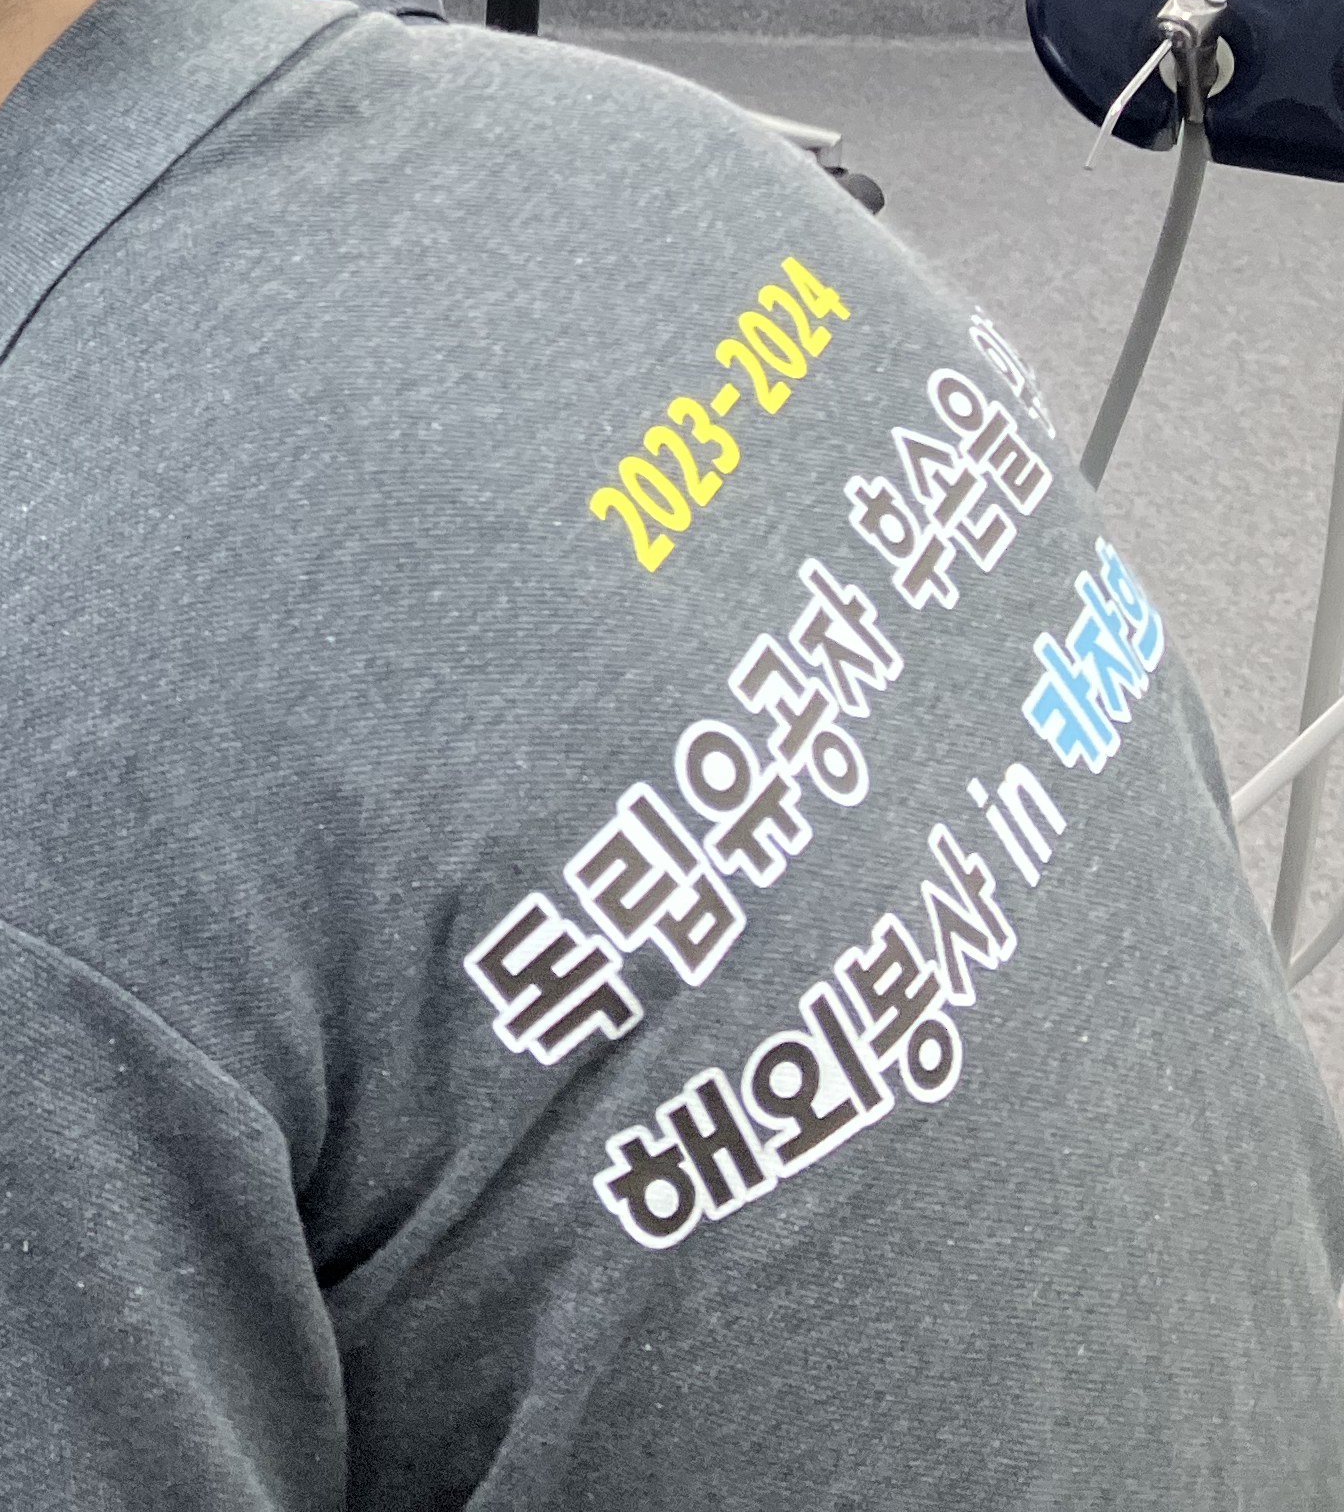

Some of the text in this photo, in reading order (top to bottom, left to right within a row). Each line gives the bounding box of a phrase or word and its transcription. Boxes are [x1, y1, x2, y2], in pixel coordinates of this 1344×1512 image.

[591, 257, 850, 572] 2023-2024
[464, 557, 905, 1066] 독립유공자
[843, 368, 1053, 610] 후손을
[593, 822, 1018, 1249] 해외봉사
[967, 763, 1067, 888] in
